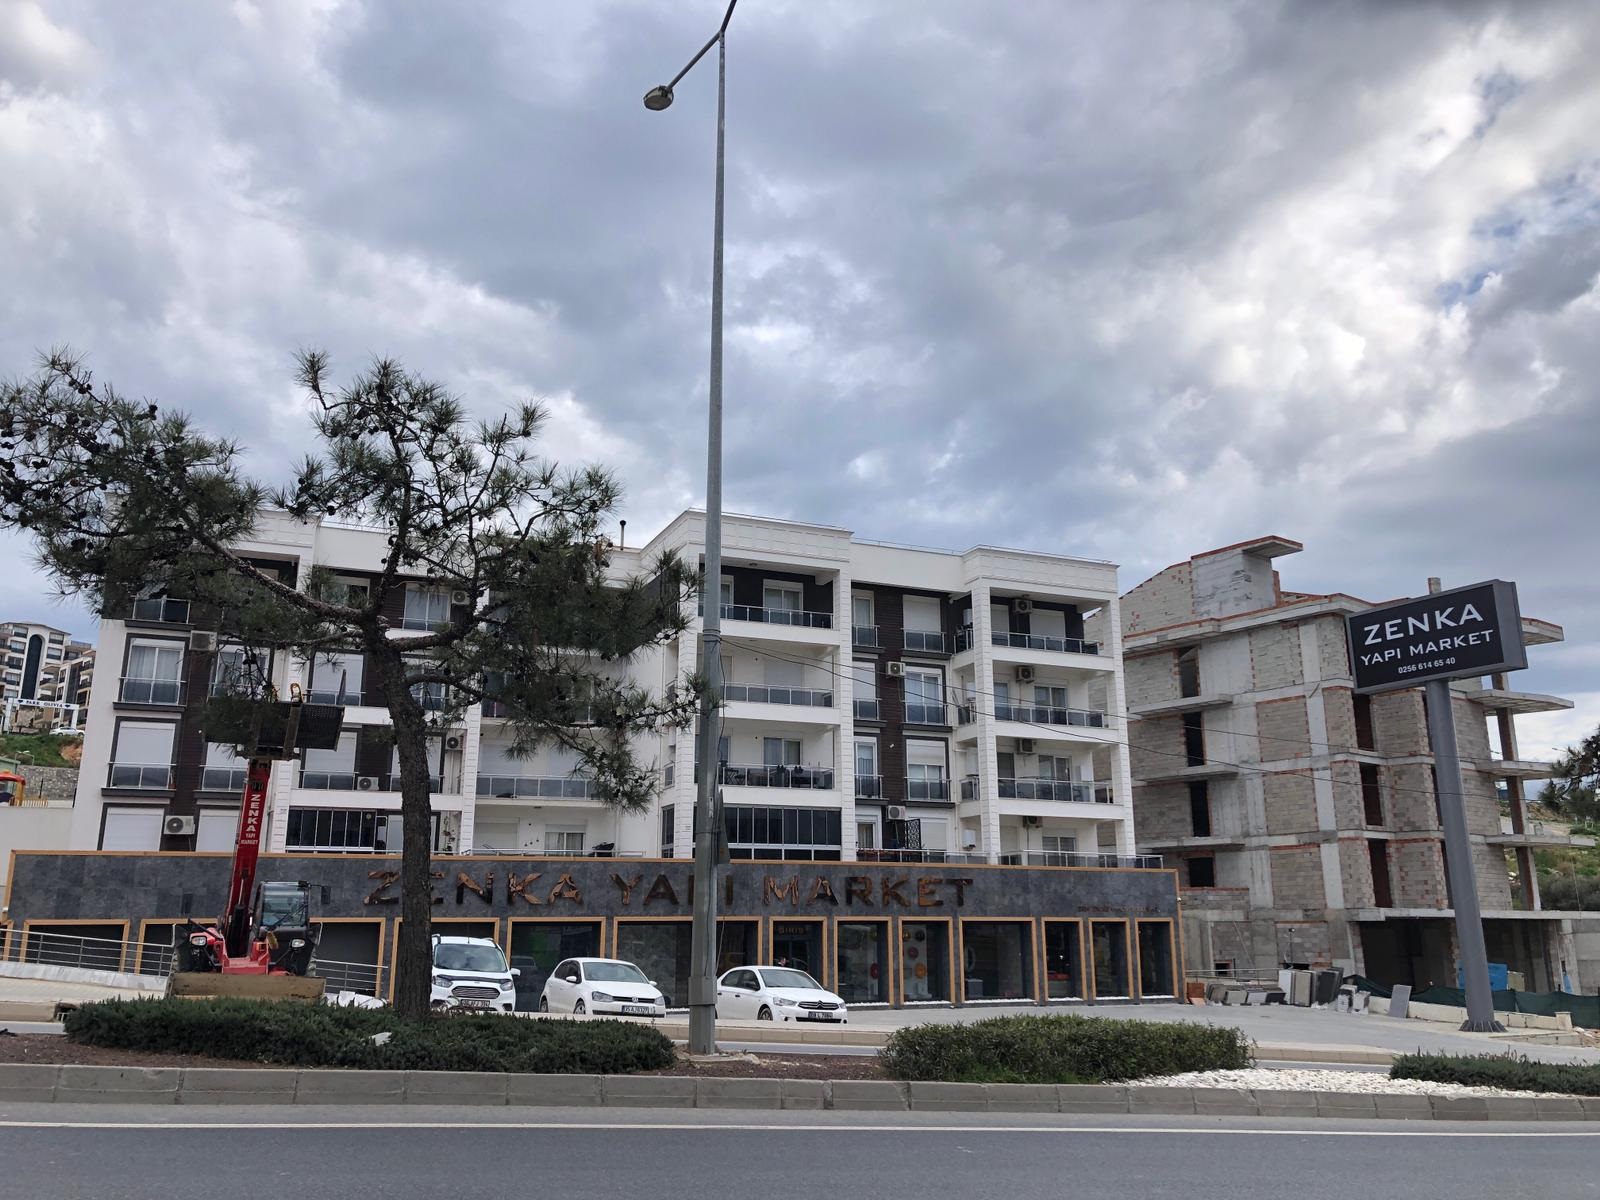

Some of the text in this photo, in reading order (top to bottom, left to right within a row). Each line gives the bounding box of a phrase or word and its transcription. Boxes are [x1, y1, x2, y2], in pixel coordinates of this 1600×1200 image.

[1363, 603, 1484, 646] ZENKA
[1360, 629, 1494, 666] YAPI MARKET
[1397, 656, 1456, 674] 0256 614 65 40
[245, 794, 262, 832] ZENKA
[609, 873, 734, 906] YAI
[763, 875, 973, 907] MARKET
